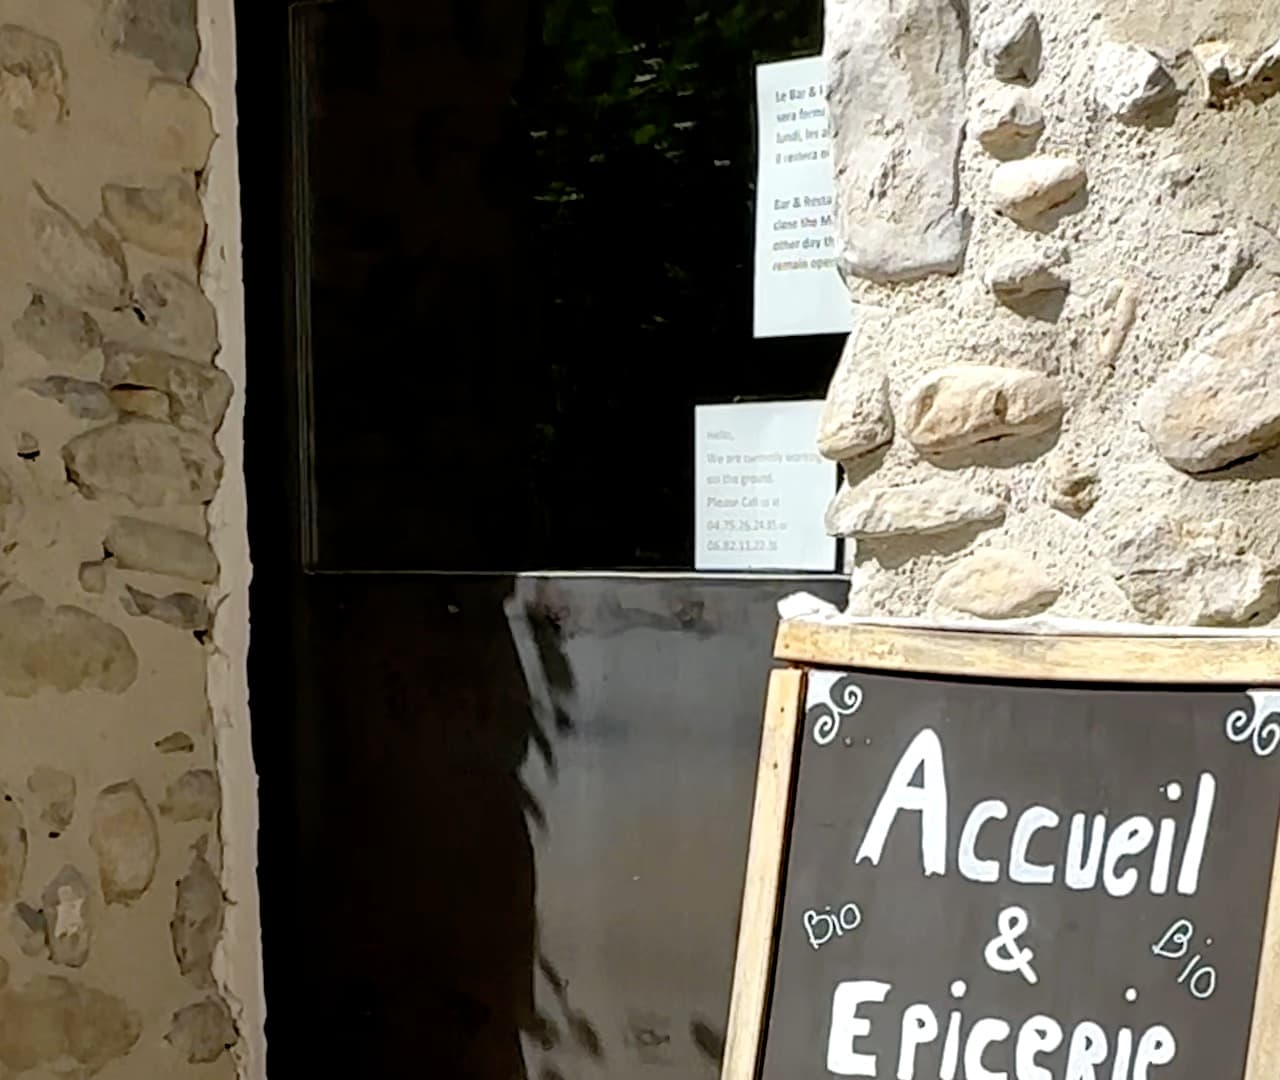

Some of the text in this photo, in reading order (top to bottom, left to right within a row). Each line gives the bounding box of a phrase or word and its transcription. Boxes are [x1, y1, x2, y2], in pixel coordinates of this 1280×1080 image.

[855, 727, 1216, 897] Accueil
[802, 900, 862, 950] Bio
[984, 905, 1040, 984] &
[1152, 919, 1217, 998] Bio
